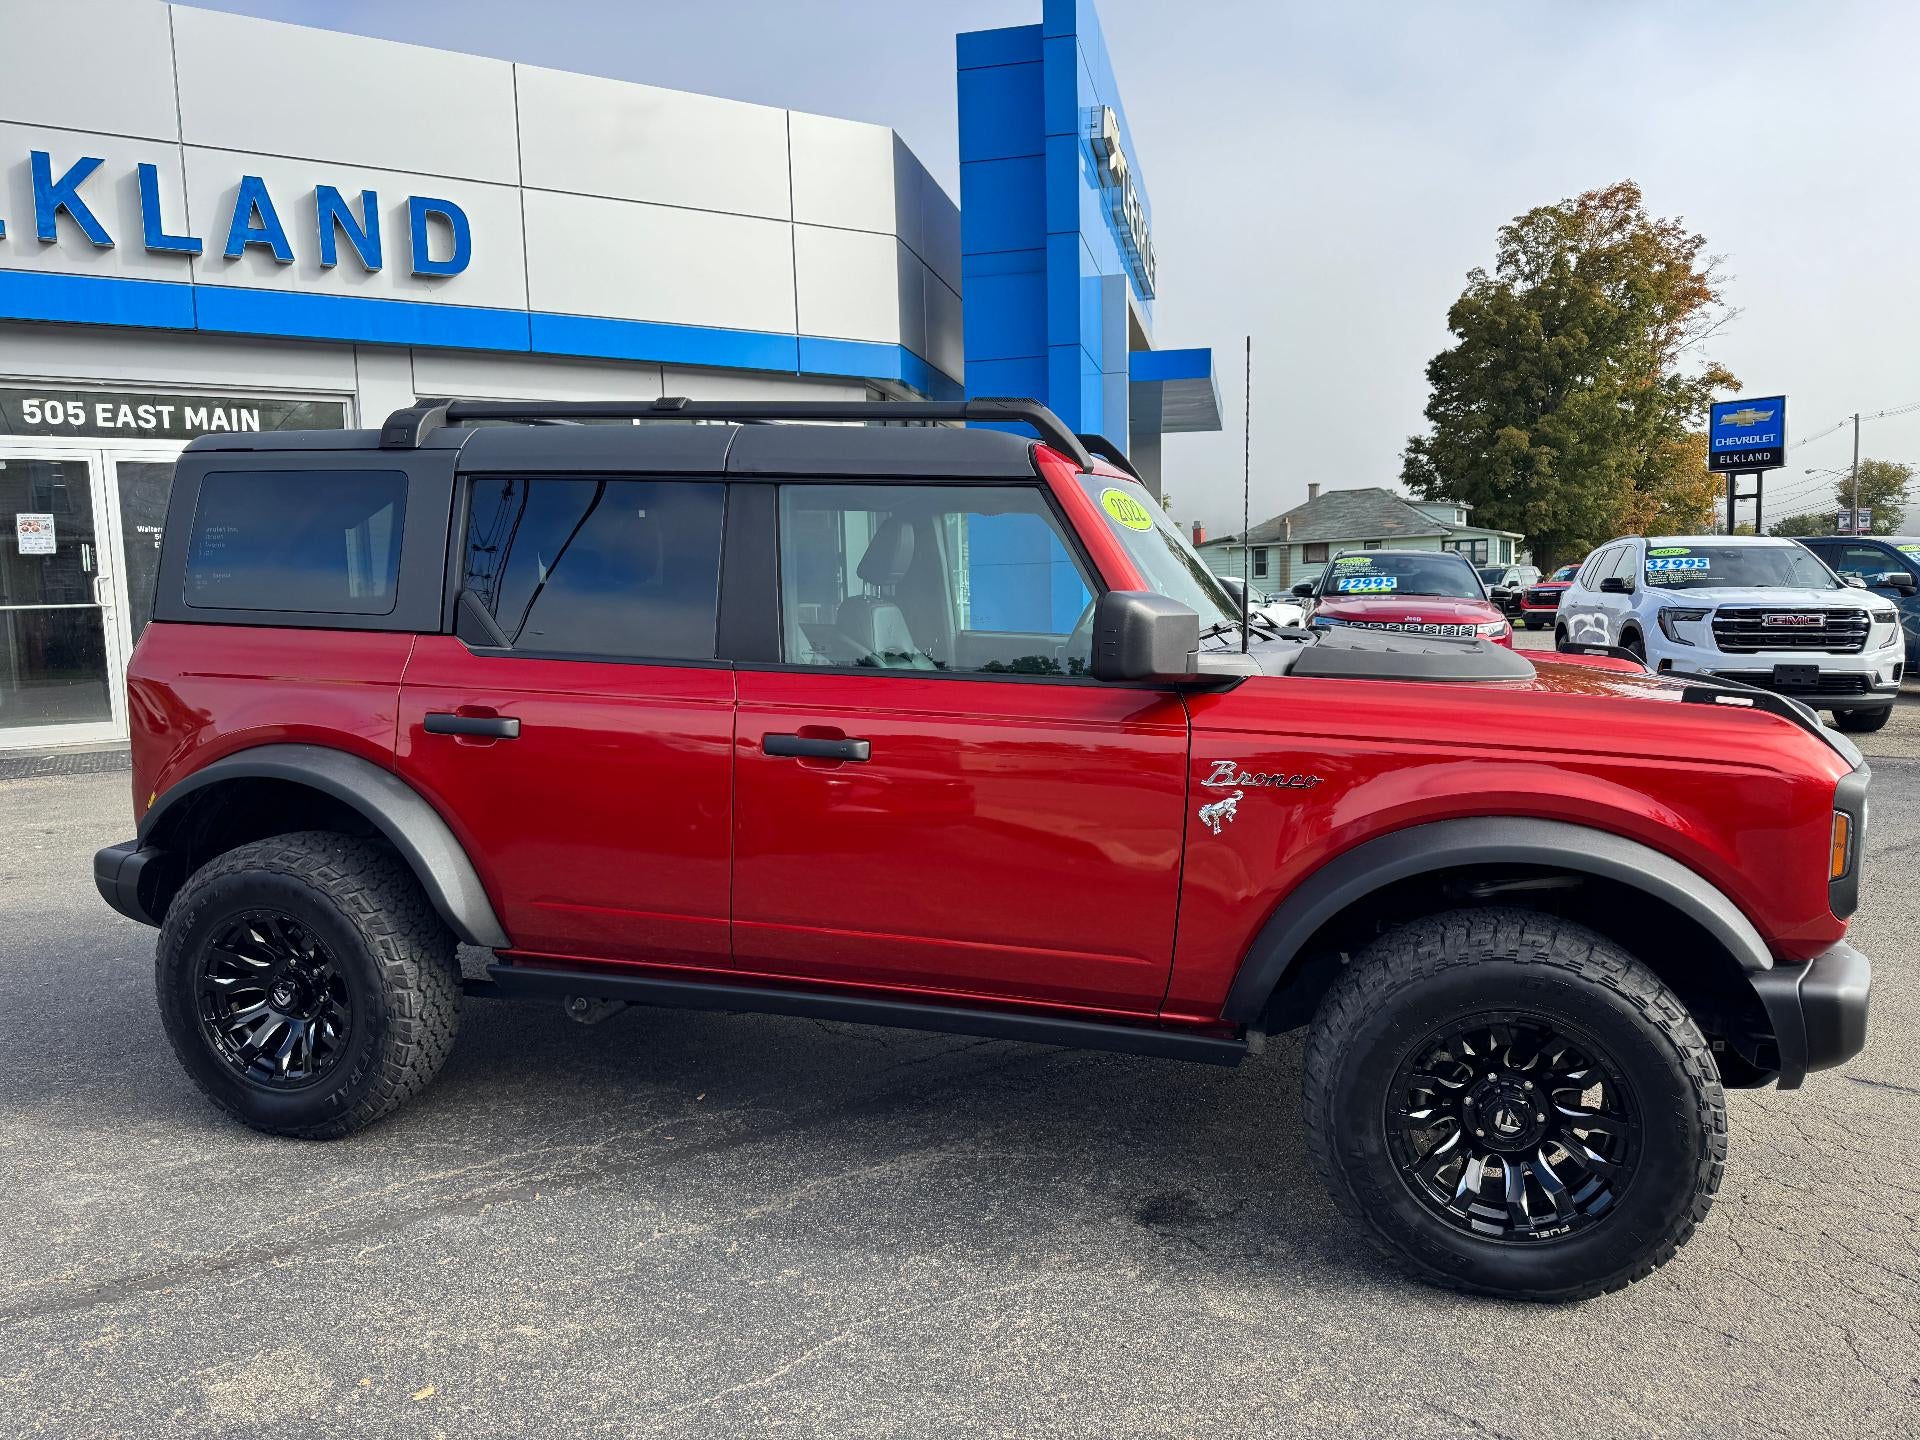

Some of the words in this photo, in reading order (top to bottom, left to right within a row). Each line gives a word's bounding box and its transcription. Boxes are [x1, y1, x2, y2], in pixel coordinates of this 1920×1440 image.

[0, 149, 472, 277] KLAND
[21, 399, 86, 426] 505
[95, 402, 175, 430] EAST
[184, 406, 260, 432] MAIN
[1715, 433, 1777, 447] CHEVROLET
[1719, 452, 1771, 464] ELKLAND
[1647, 558, 1708, 570] 32995
[1340, 577, 1395, 589] 22995
[1768, 614, 1822, 626] GMC
[1200, 760, 1325, 788] Bronco
[1528, 1224, 1571, 1239] FUEL
